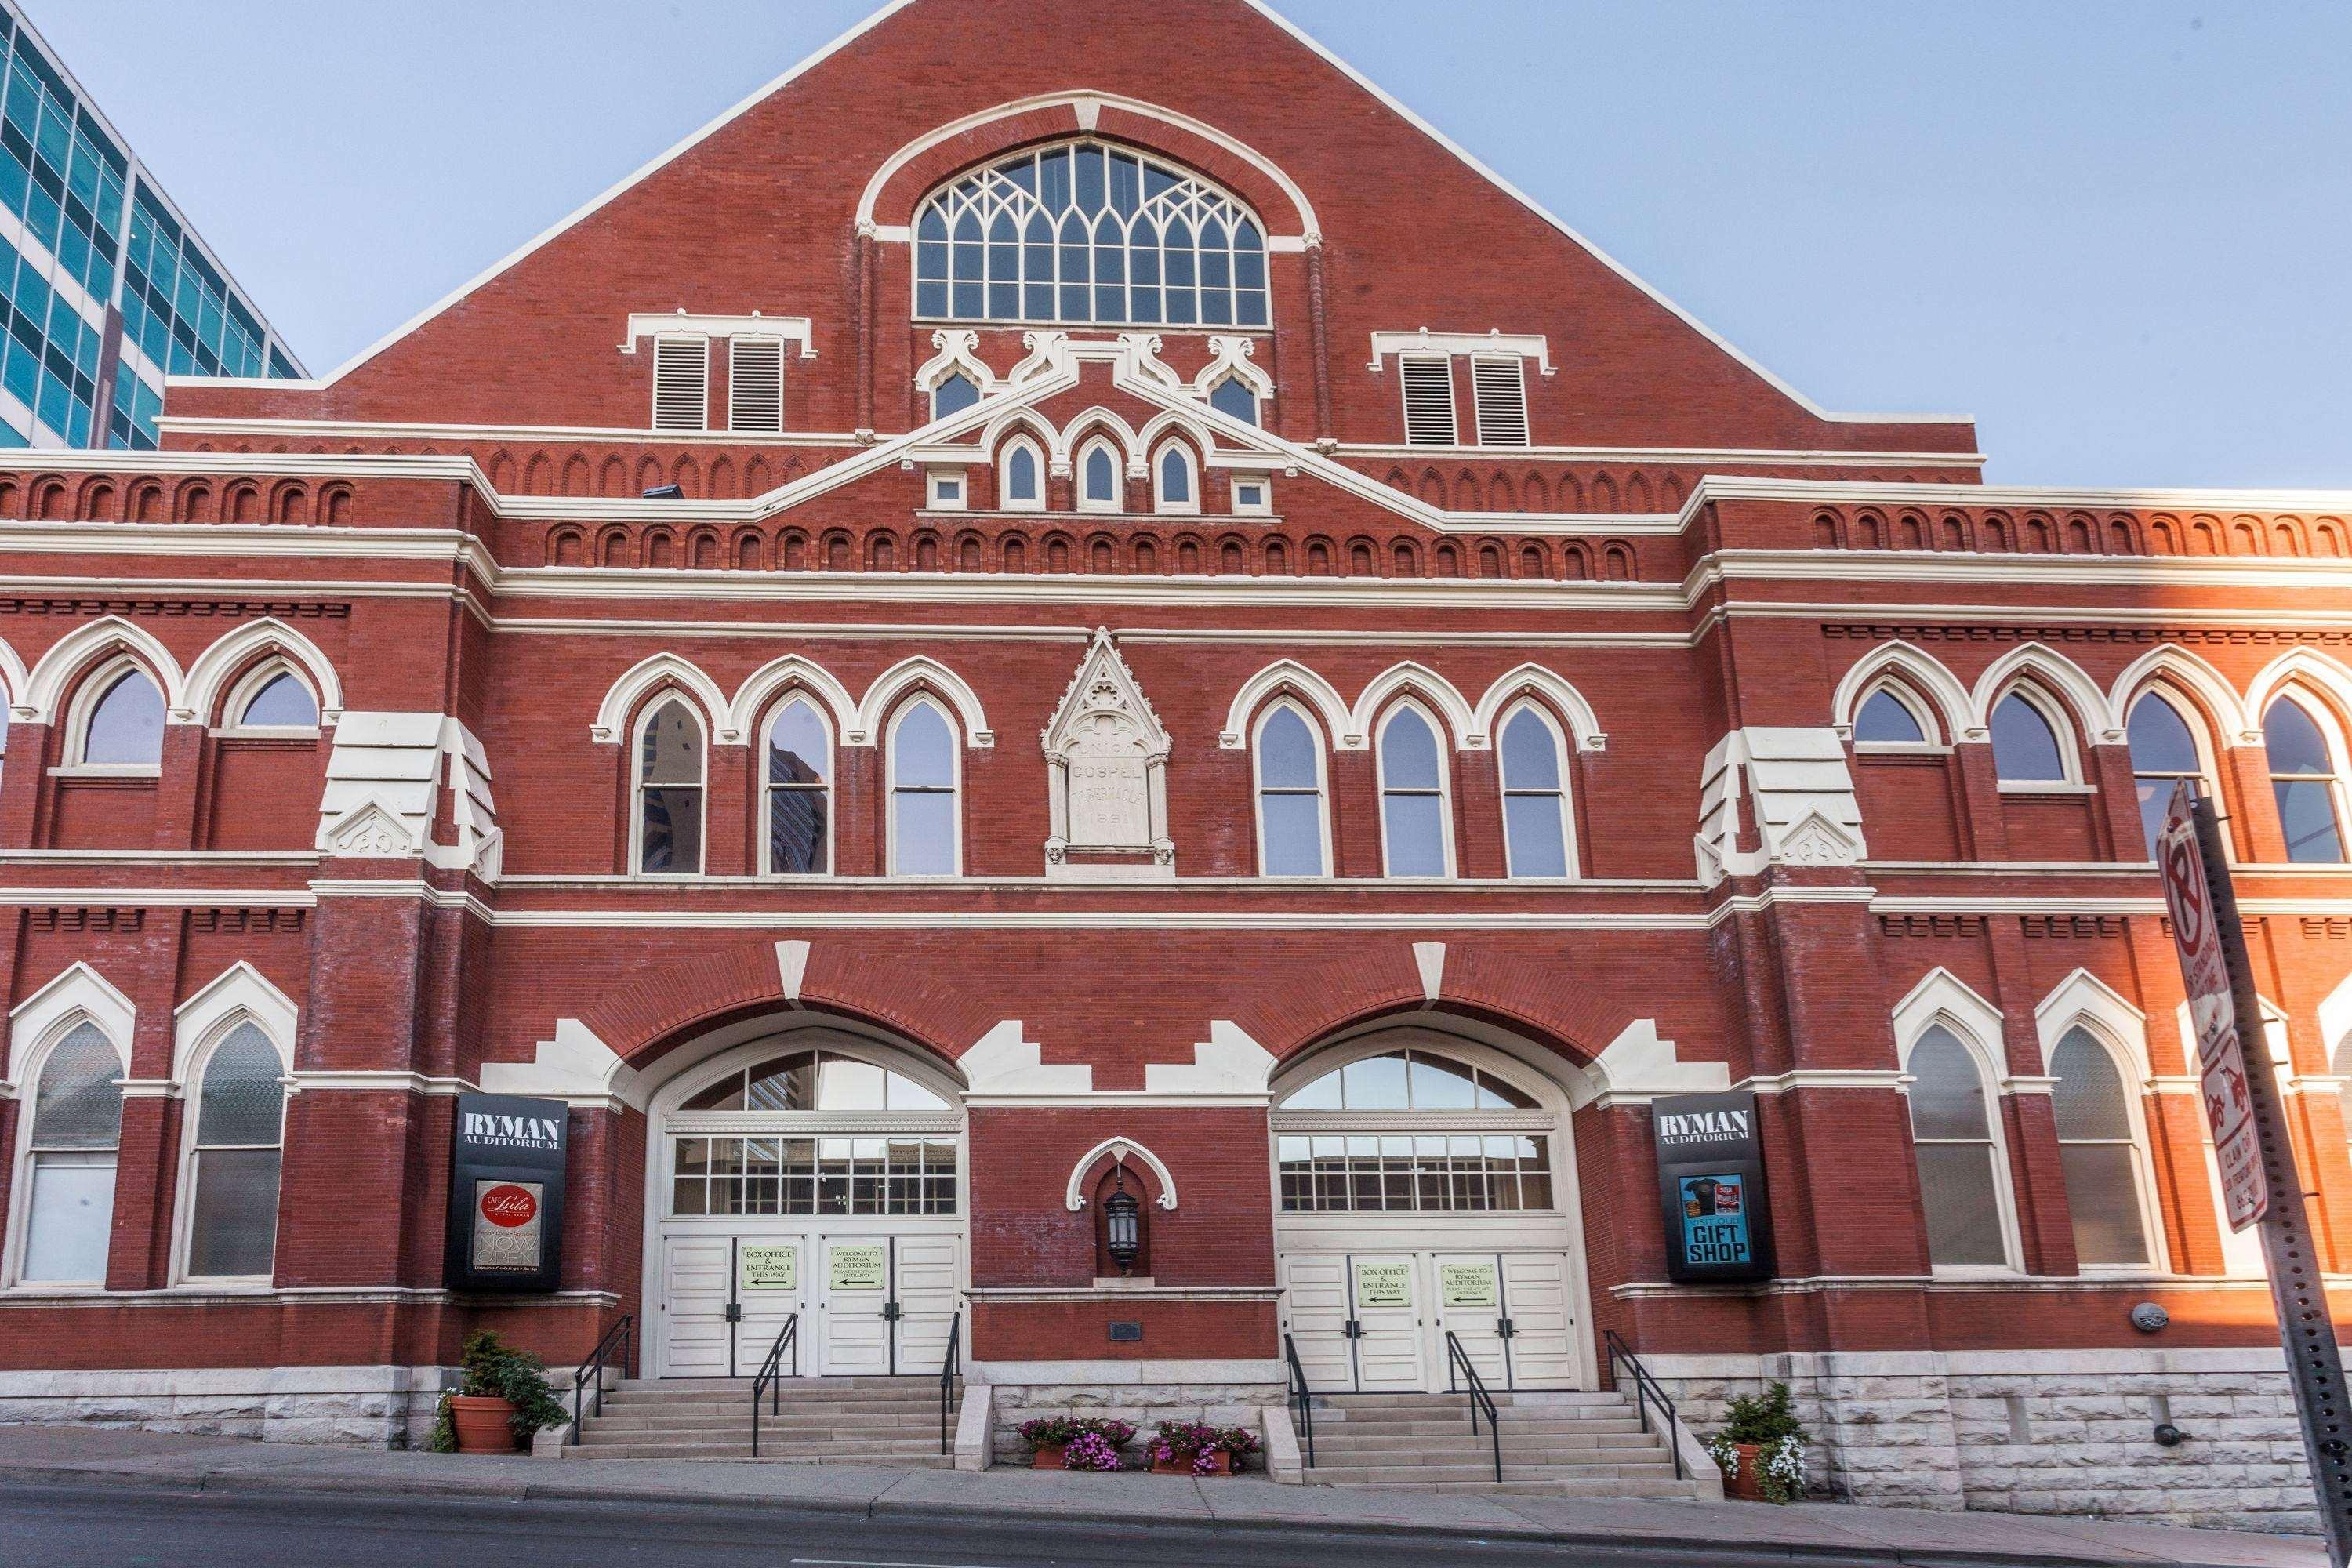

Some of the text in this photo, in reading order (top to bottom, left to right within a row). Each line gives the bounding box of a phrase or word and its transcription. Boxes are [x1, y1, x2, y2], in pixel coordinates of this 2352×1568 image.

[1076, 742, 1136, 754] UNION
[1073, 767, 1142, 778] GOSPEL
[463, 1112, 560, 1141] RYMAN
[1660, 1110, 1748, 1137] RYMAN
[463, 1135, 557, 1149] AUDITORIUM
[1662, 1131, 1749, 1145] AUDITORIUM
[487, 1196, 528, 1212] Lula
[1693, 1225, 1738, 1244] GIFT
[479, 1236, 539, 1252] NOW
[477, 1250, 534, 1265] OPEN
[1690, 1243, 1746, 1262] SHOP
